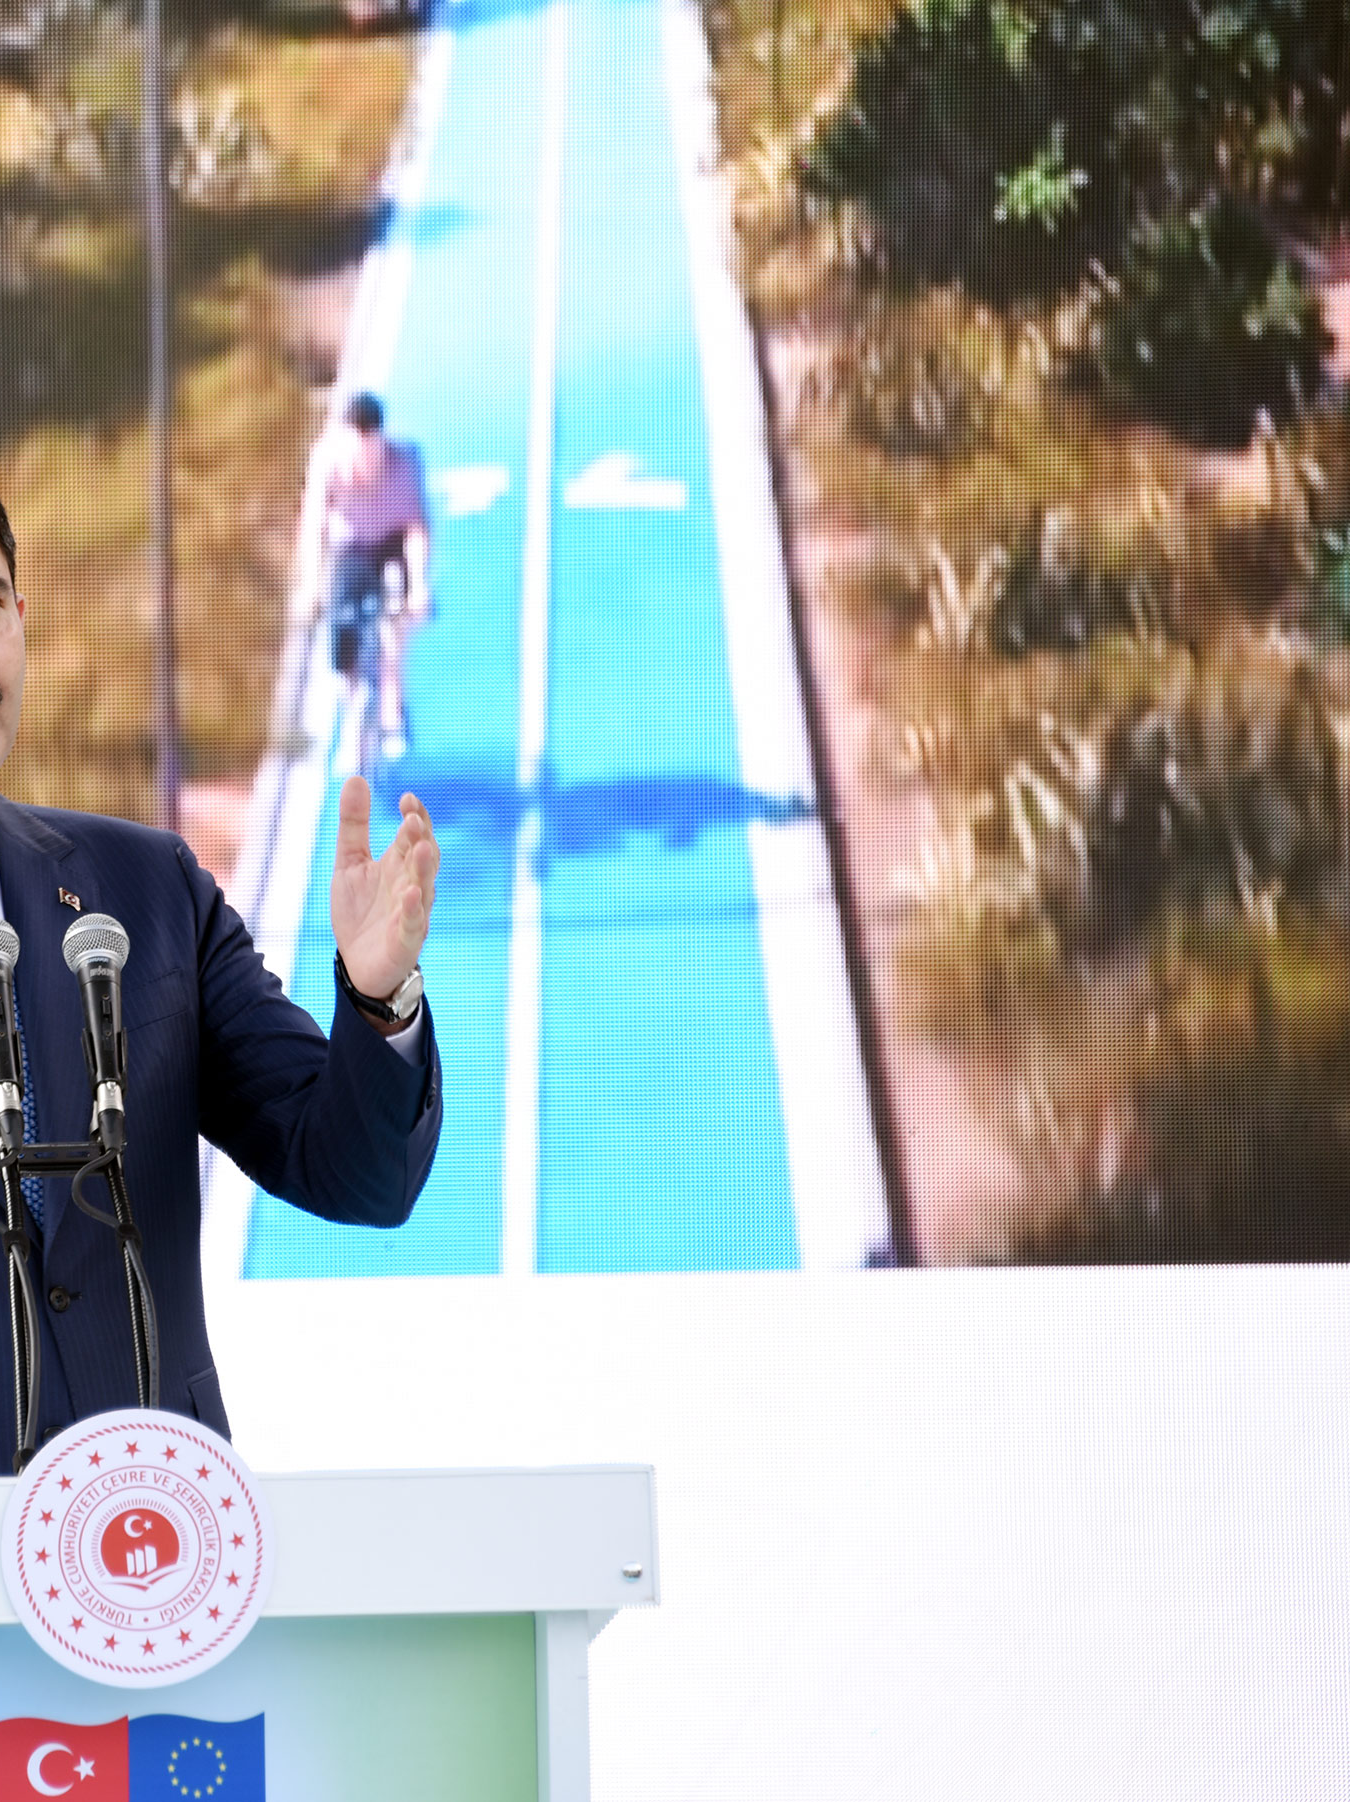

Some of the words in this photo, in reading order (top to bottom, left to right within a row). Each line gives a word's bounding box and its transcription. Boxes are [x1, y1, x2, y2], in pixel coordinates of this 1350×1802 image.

[101, 1470, 147, 1494] ÇEVRE
[153, 1472, 171, 1488] VE
[64, 1486, 100, 1585] CUMHURİYETİ
[171, 1482, 217, 1552] ŞEHİRCİLİK
[78, 1586, 133, 1626] TÜRKİYE
[159, 1557, 215, 1624] BAKANLIĞI
